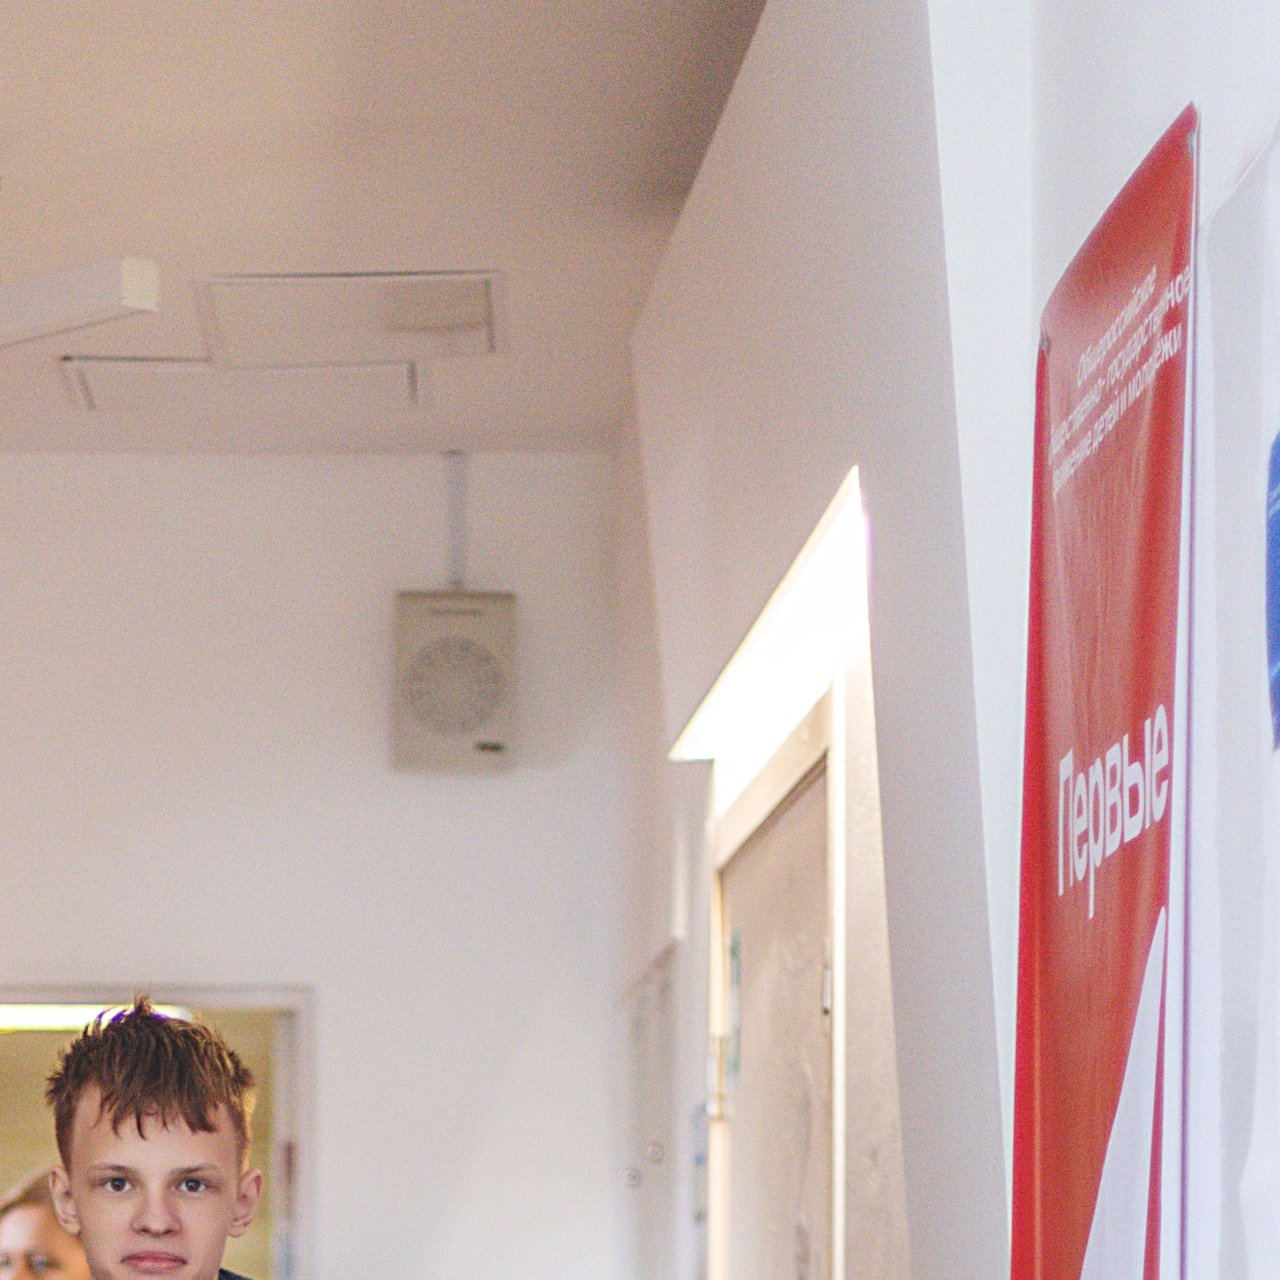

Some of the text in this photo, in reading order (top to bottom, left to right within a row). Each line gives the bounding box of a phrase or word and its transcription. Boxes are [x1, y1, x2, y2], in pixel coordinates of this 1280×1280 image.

[1092, 387, 1120, 455] детей
[1120, 386, 1128, 417] и
[1058, 704, 1169, 919] Первые
